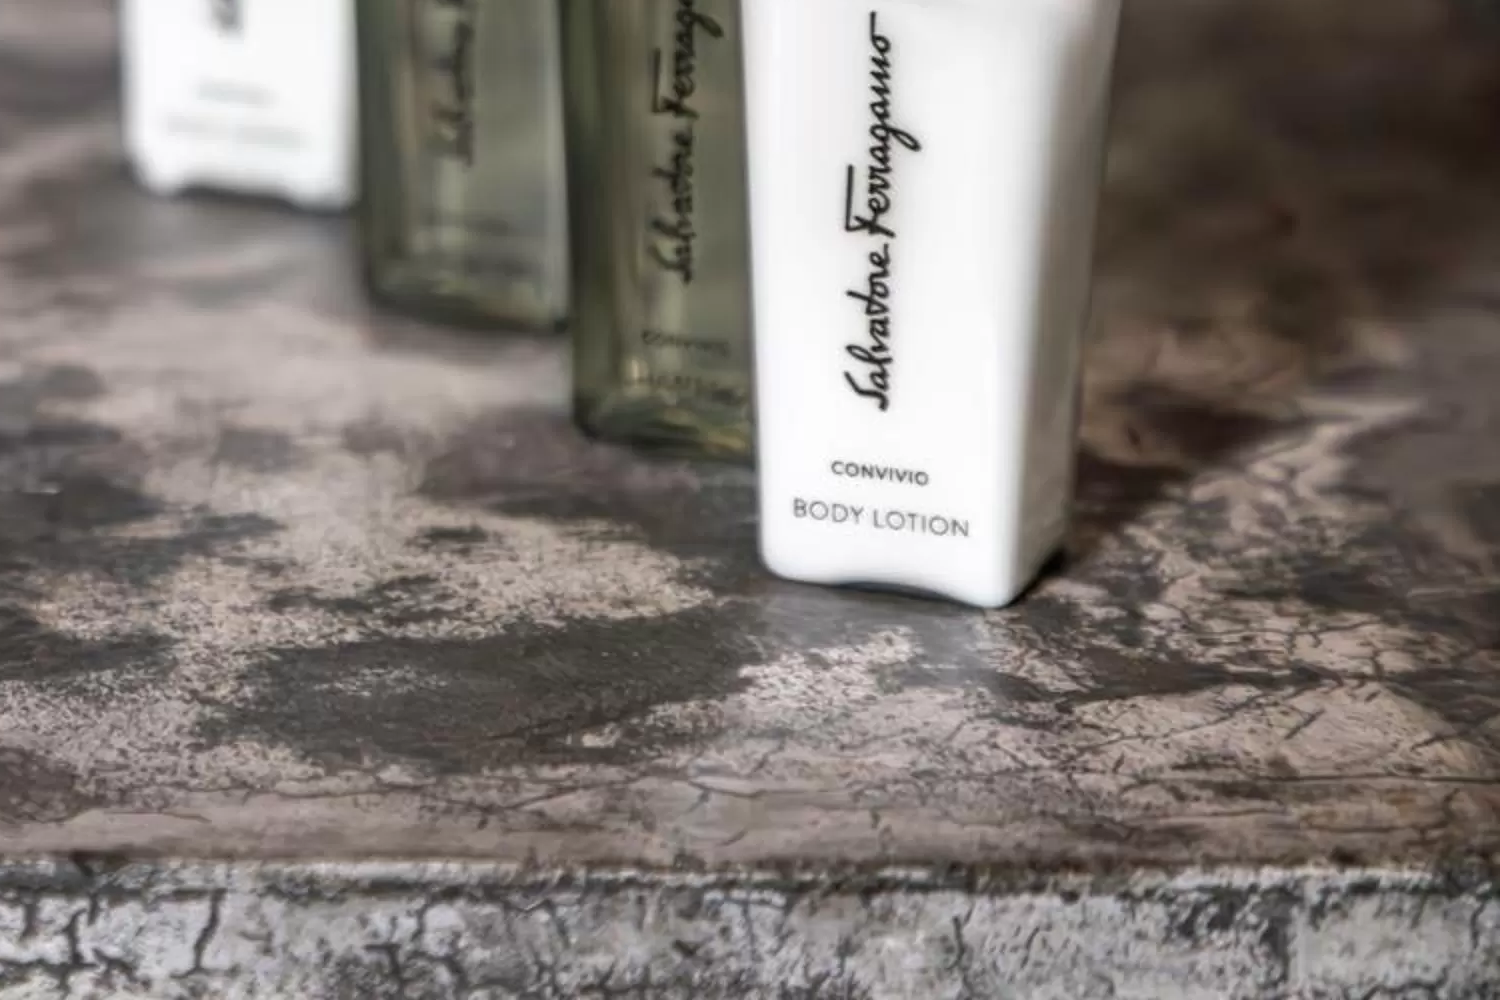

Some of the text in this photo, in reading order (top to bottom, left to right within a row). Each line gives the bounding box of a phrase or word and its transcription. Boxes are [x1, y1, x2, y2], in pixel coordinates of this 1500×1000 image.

[844, 10, 922, 412] Salvatore Ferragamo
[830, 460, 930, 487] CONVIVIO
[792, 497, 970, 538] BODY LOTION
